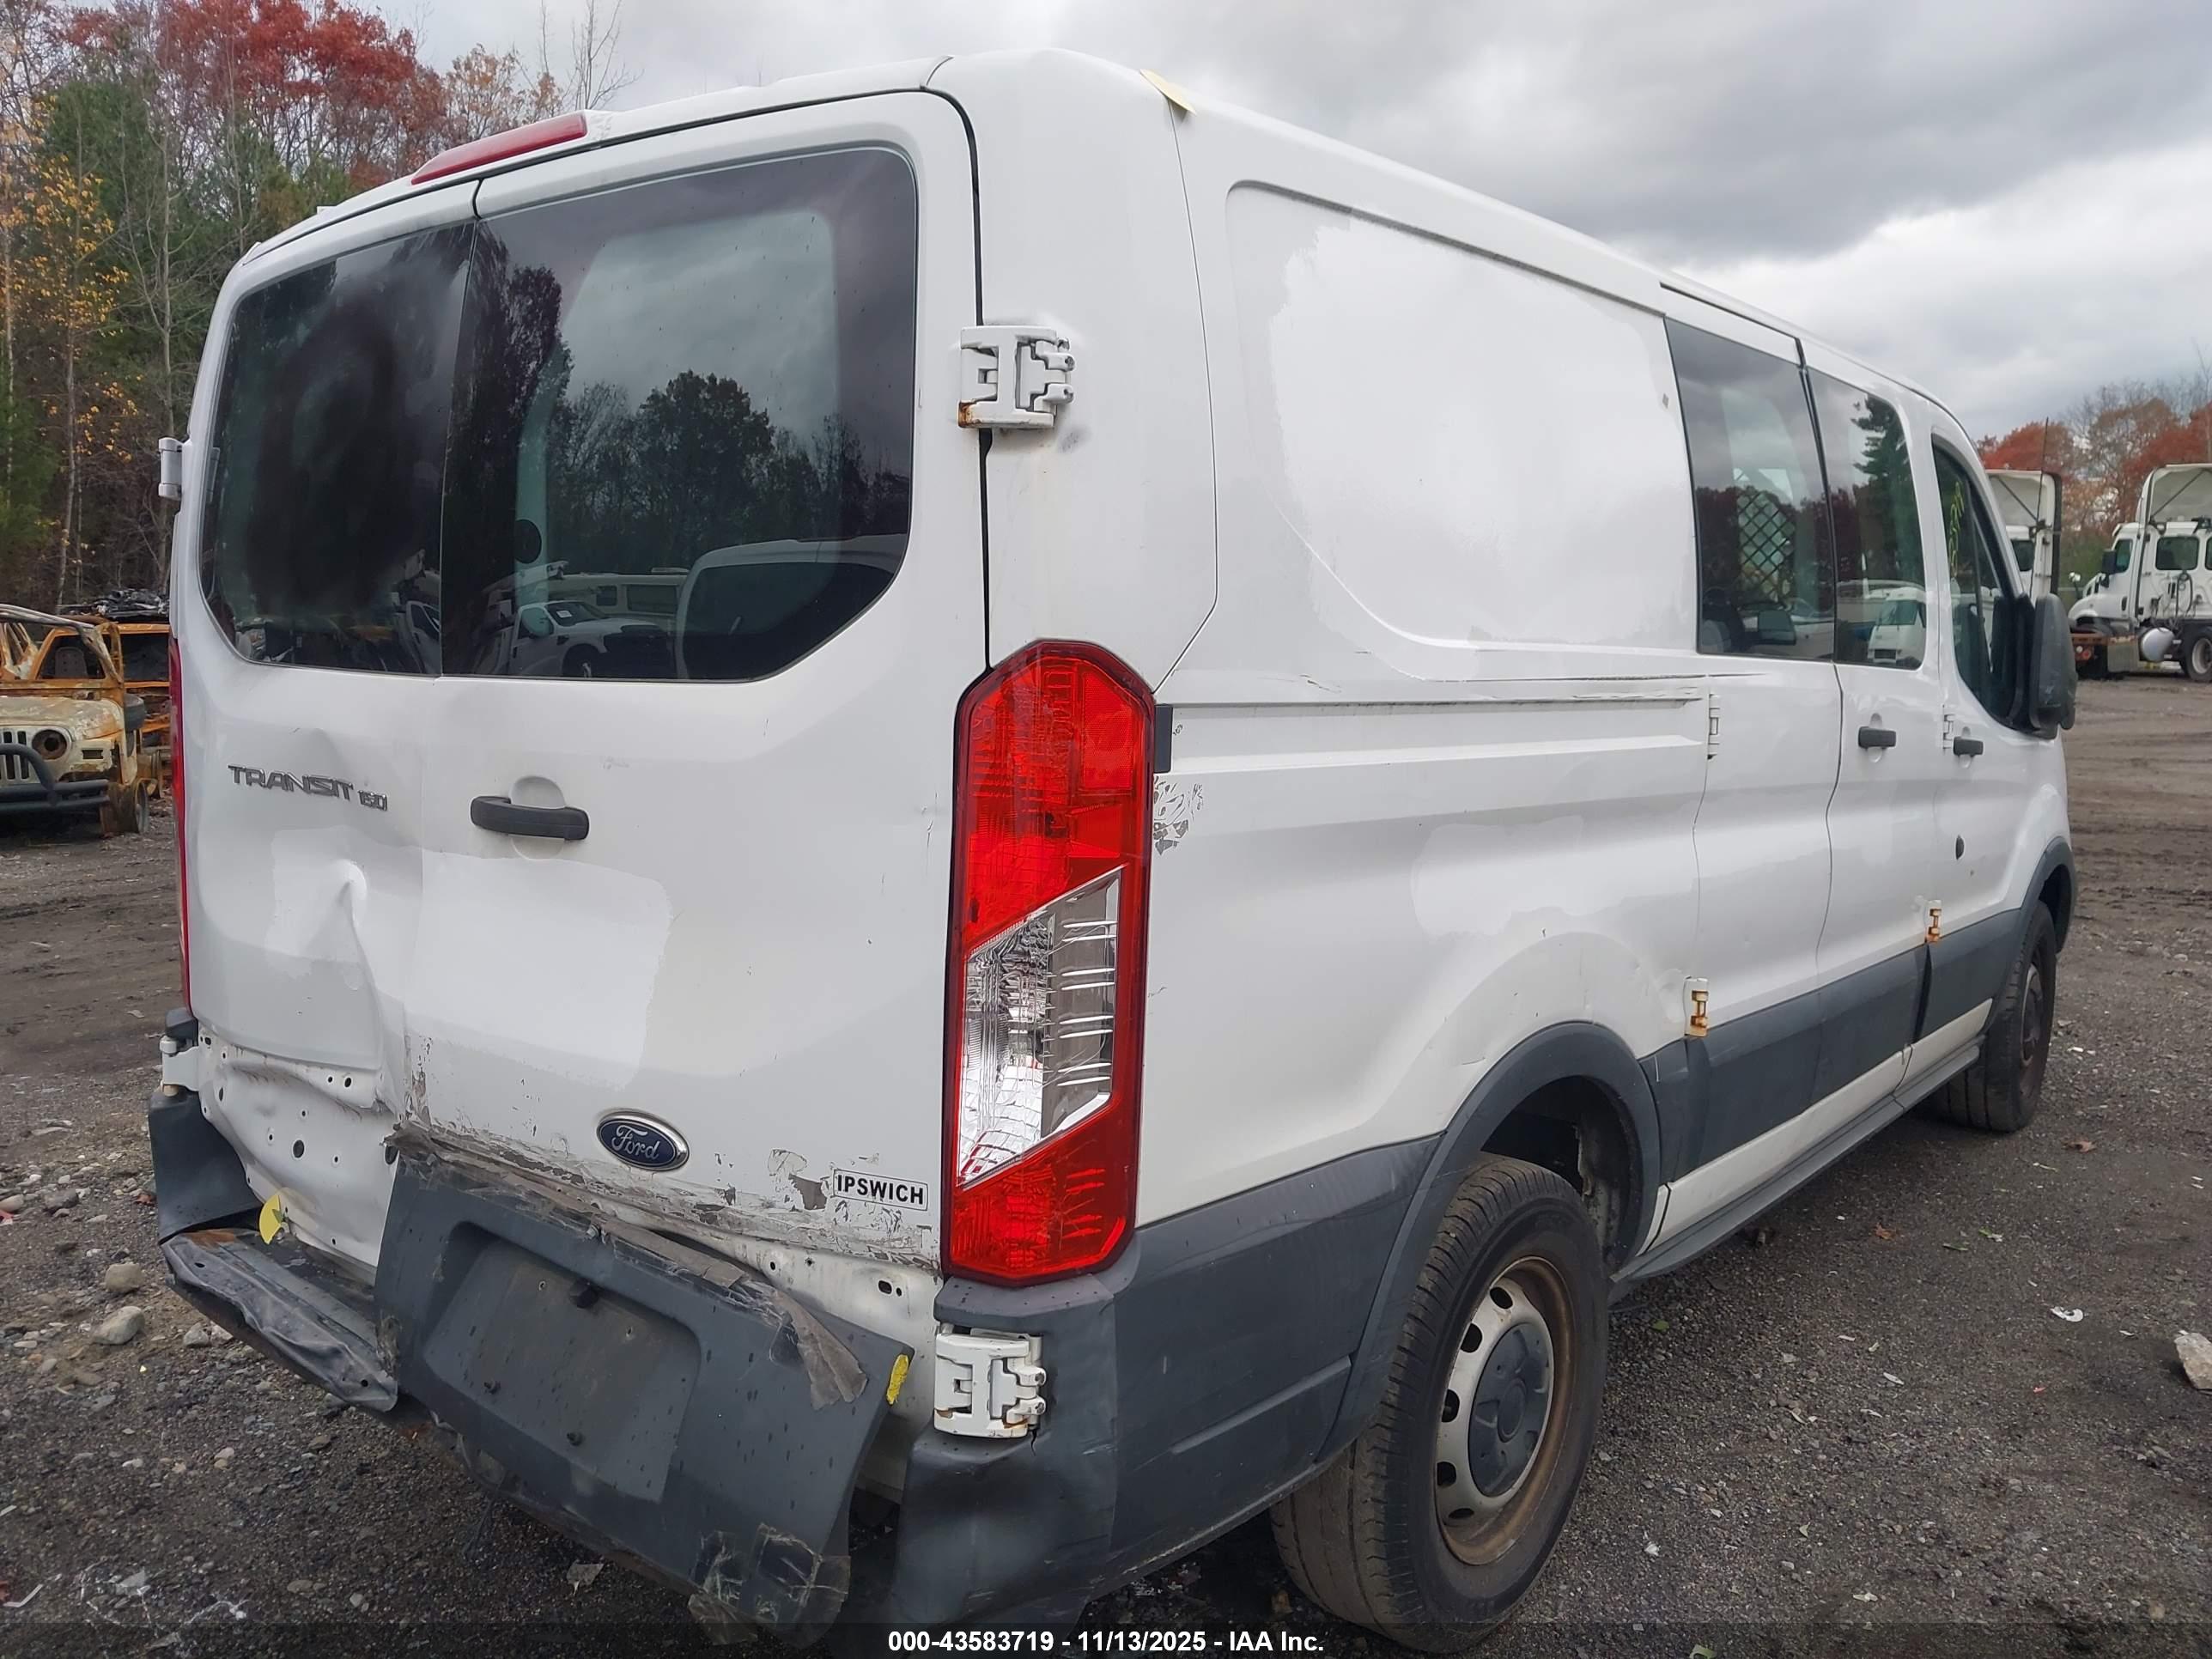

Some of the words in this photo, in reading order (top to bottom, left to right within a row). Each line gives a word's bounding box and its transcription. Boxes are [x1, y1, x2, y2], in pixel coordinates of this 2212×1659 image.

[227, 764, 354, 801] TRANSIT
[611, 1123, 661, 1161] Ford
[836, 1173, 925, 1206] IPSWICH
